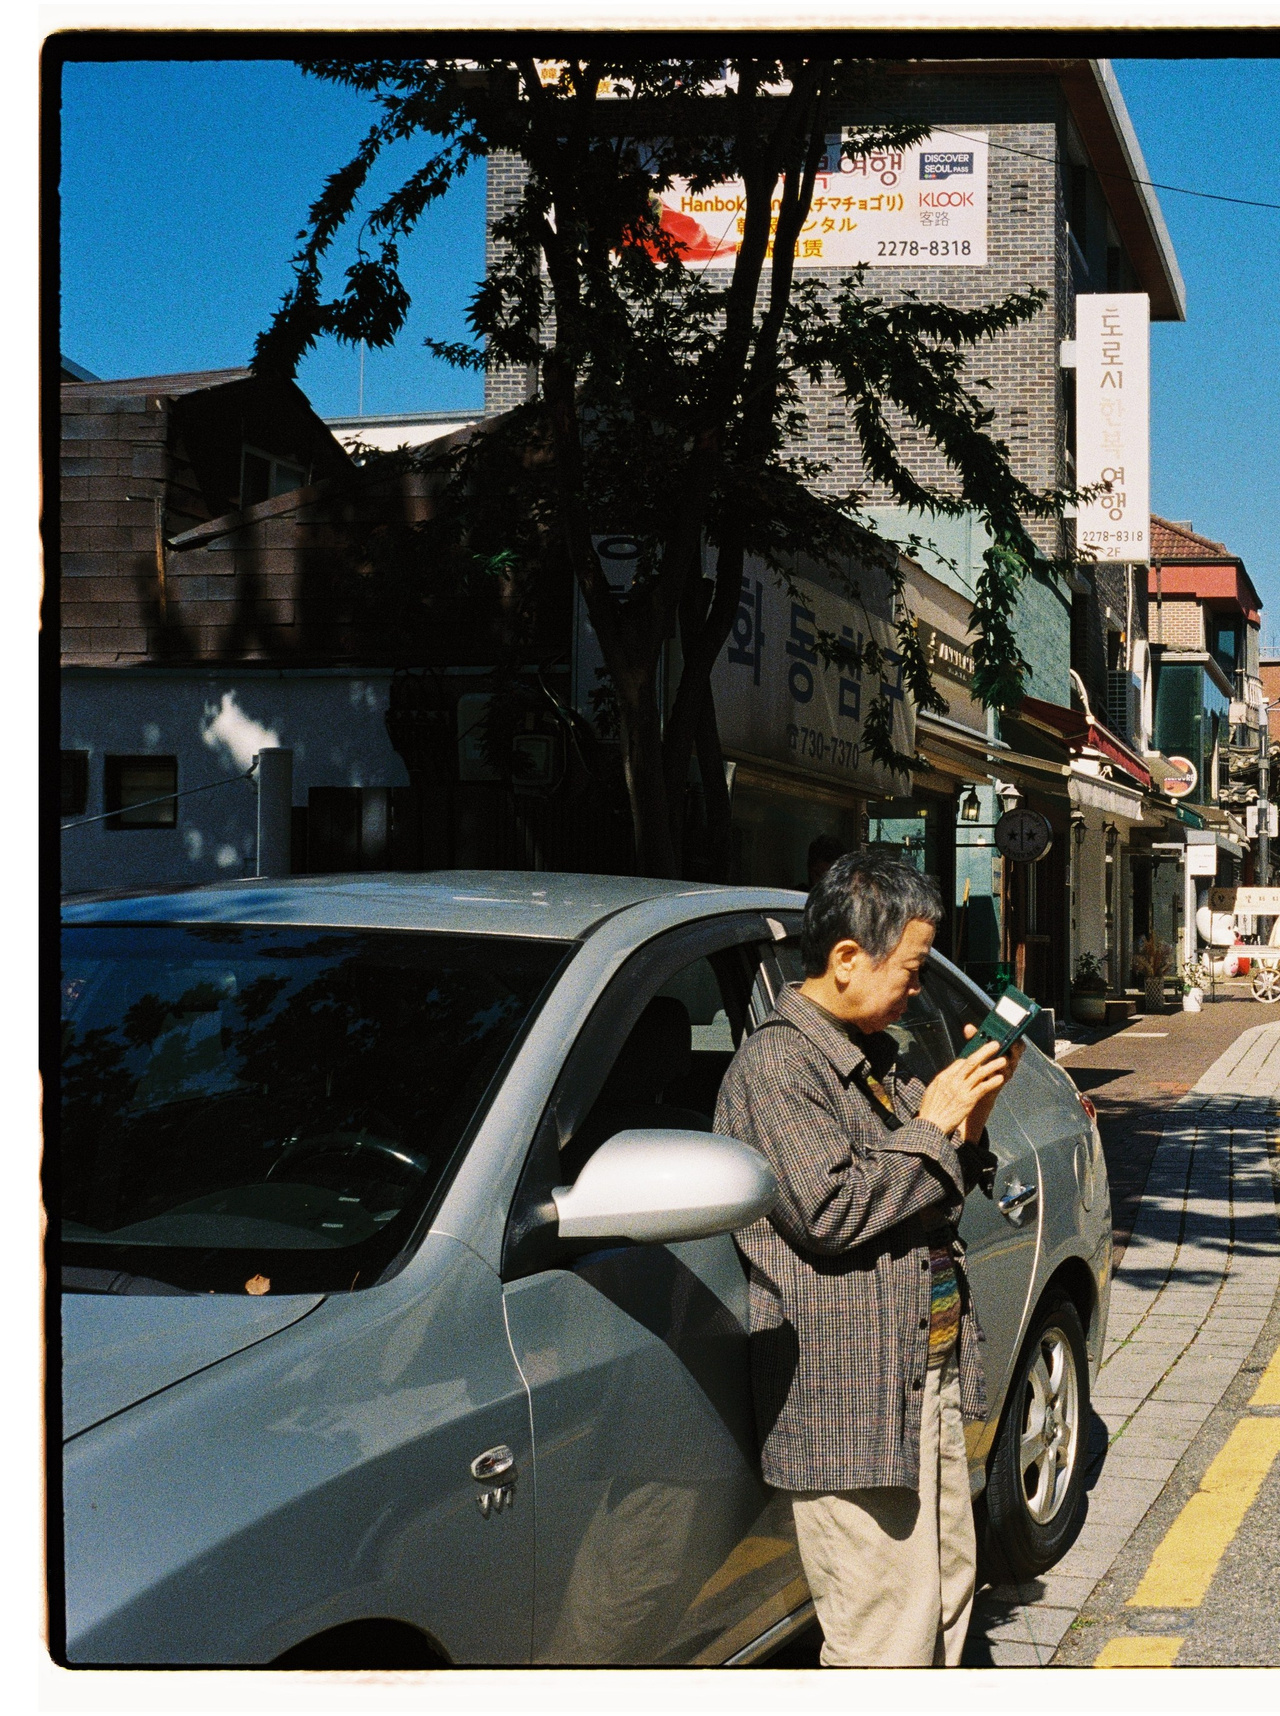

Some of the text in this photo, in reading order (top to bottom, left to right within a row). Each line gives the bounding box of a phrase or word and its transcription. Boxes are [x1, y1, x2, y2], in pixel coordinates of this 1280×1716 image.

[924, 153, 969, 163] DISCOVER
[924, 164, 952, 173] SEOUL
[681, 196, 746, 212] Hanbok
[919, 191, 974, 207] KLOOK
[919, 210, 950, 227] 客路
[877, 239, 972, 257] 2278-8318
[1100, 308, 1124, 390] 도로시
[1100, 466, 1127, 522] 여행
[1082, 530, 1144, 547] 2278-8318
[1106, 547, 1122, 558] 2F
[801, 725, 860, 770] 730-7370
